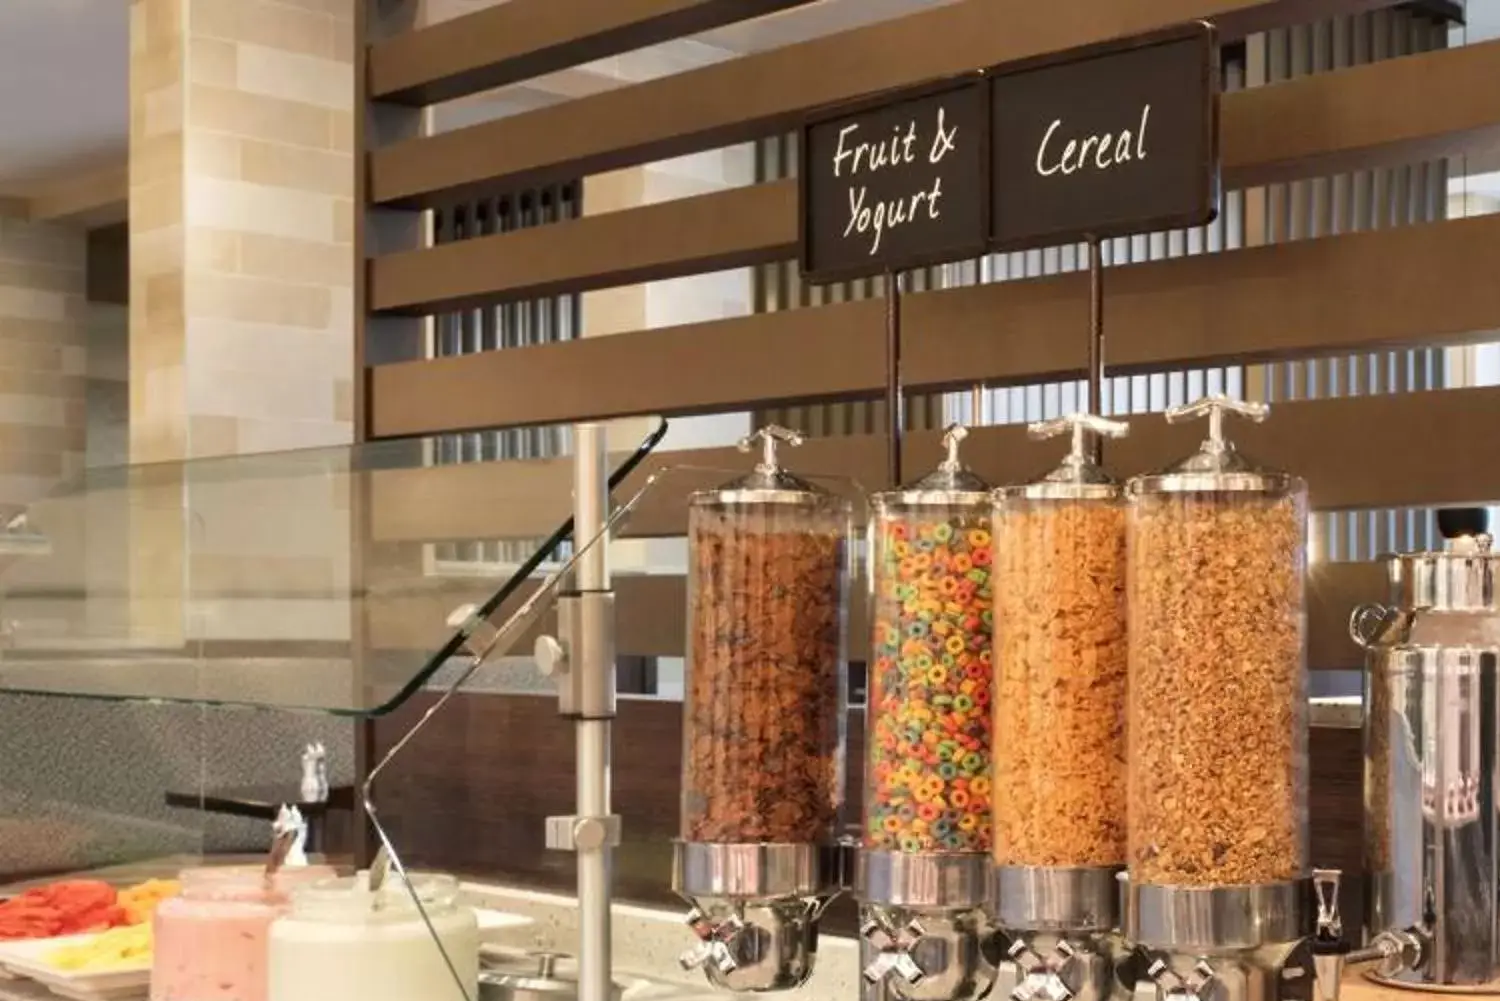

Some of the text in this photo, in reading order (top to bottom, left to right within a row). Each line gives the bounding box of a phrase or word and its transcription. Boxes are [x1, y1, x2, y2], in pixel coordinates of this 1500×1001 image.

[833, 107, 959, 177] Fruit &
[1036, 104, 1151, 176] Cereal
[844, 177, 942, 255] Yogurt
